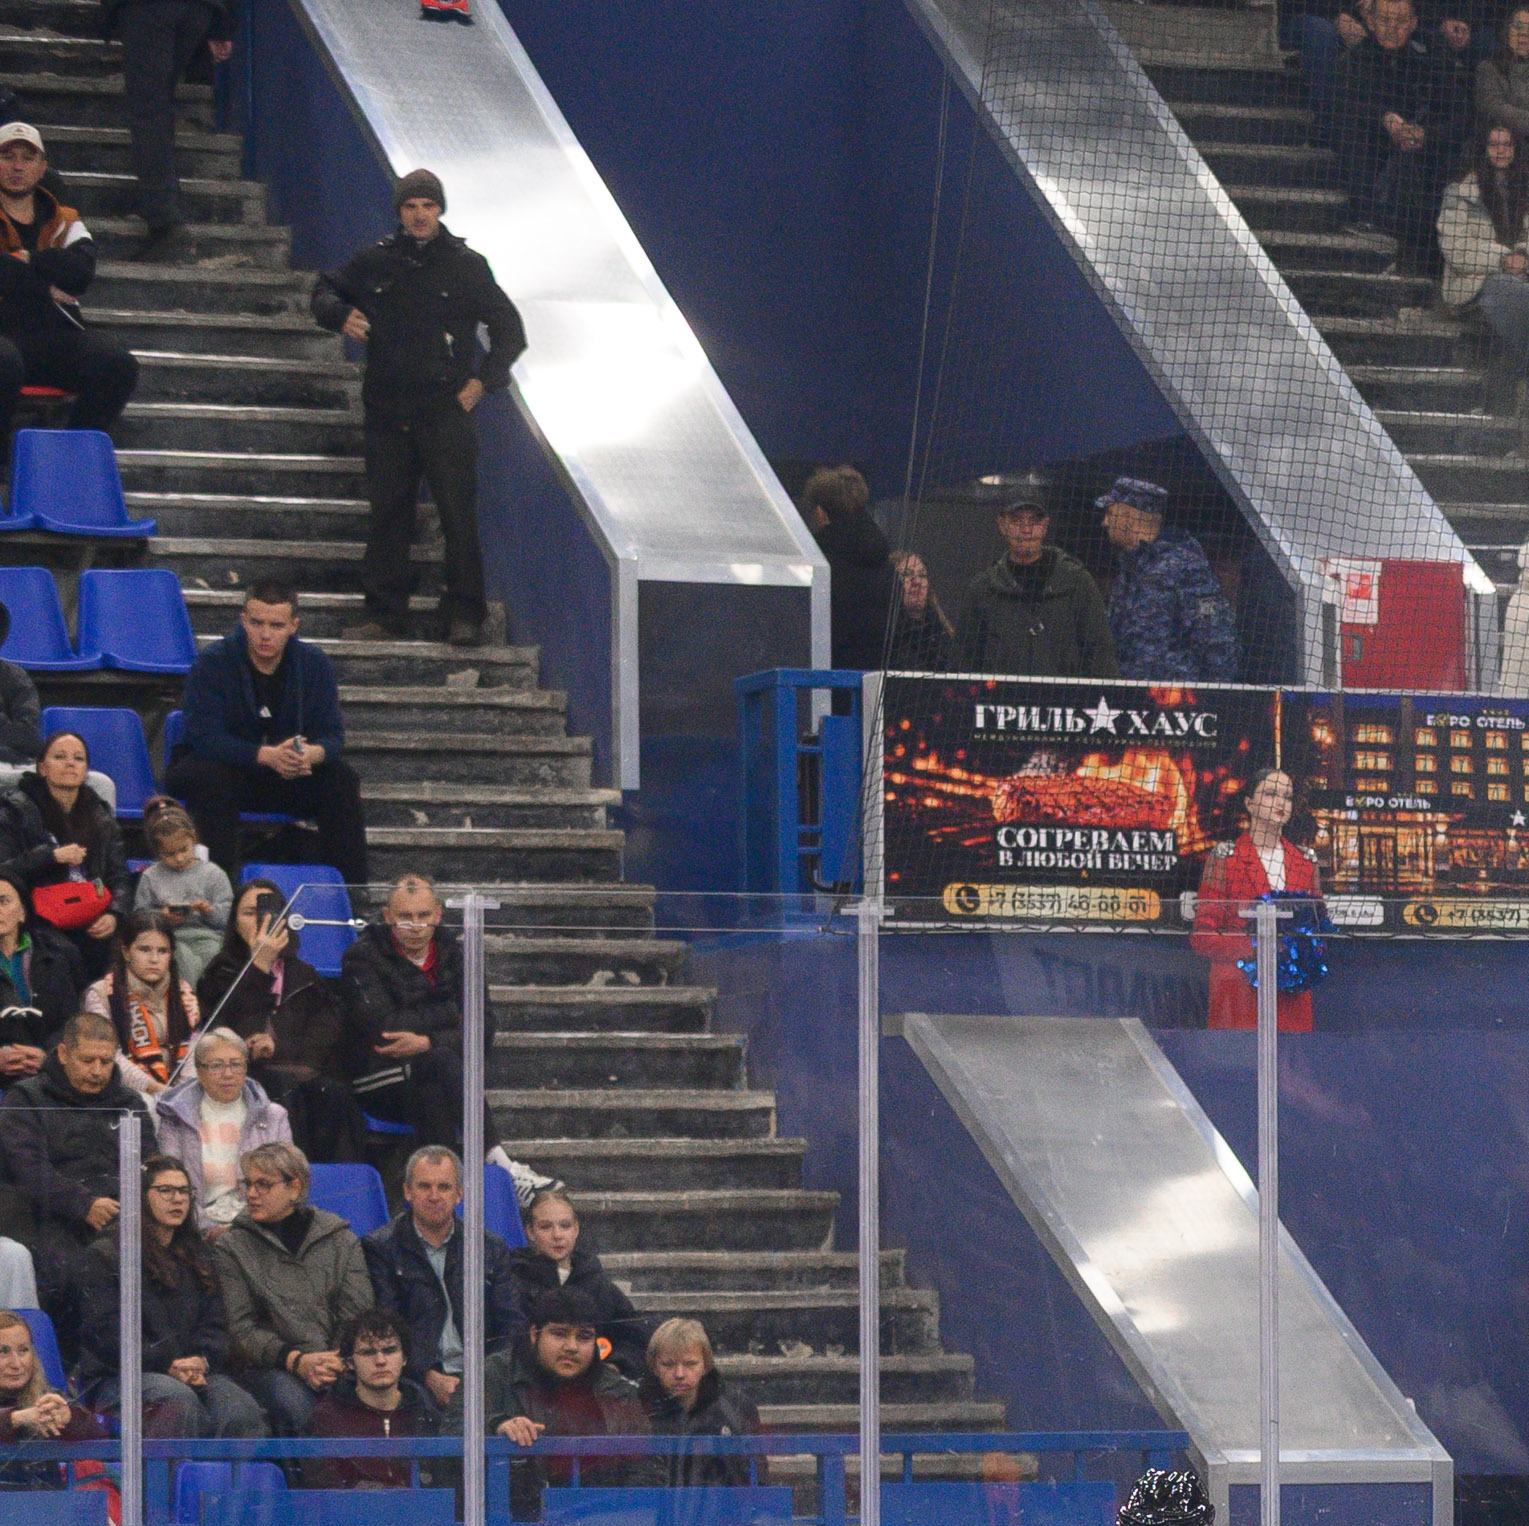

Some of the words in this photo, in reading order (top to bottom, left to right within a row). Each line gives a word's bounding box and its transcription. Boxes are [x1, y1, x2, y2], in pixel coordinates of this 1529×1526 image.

[975, 704, 1085, 733] ГРИЛЬ
[1126, 710, 1218, 738] ХАУС
[1477, 715, 1526, 730] ОТЕЛЬ
[997, 827, 1175, 853] СОГРЕВАЕМ
[999, 850, 1013, 867] В
[1018, 850, 1102, 870] ЛЮБОЙ
[1108, 853, 1178, 872] ВЕЧЕР
[1010, 892, 1061, 914] (3537)
